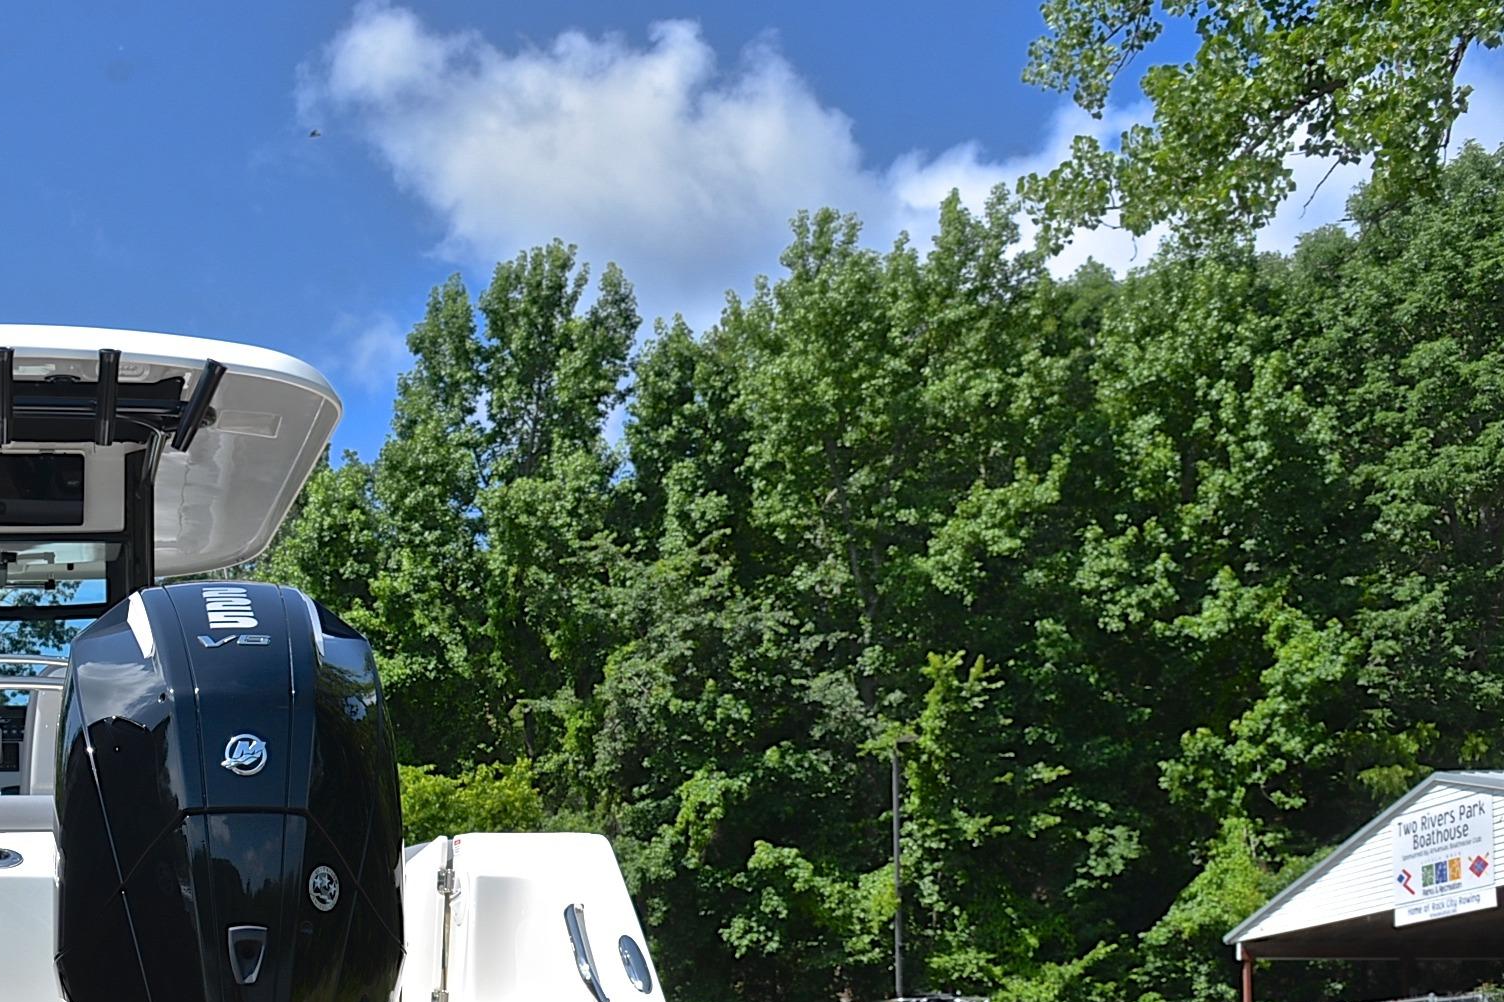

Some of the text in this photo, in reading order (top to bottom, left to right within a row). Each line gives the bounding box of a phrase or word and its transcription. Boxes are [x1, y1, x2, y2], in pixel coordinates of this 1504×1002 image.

[197, 634, 271, 648] V6
[1397, 800, 1486, 837] Two Rivers Park
[1413, 823, 1469, 850] Boathouse
